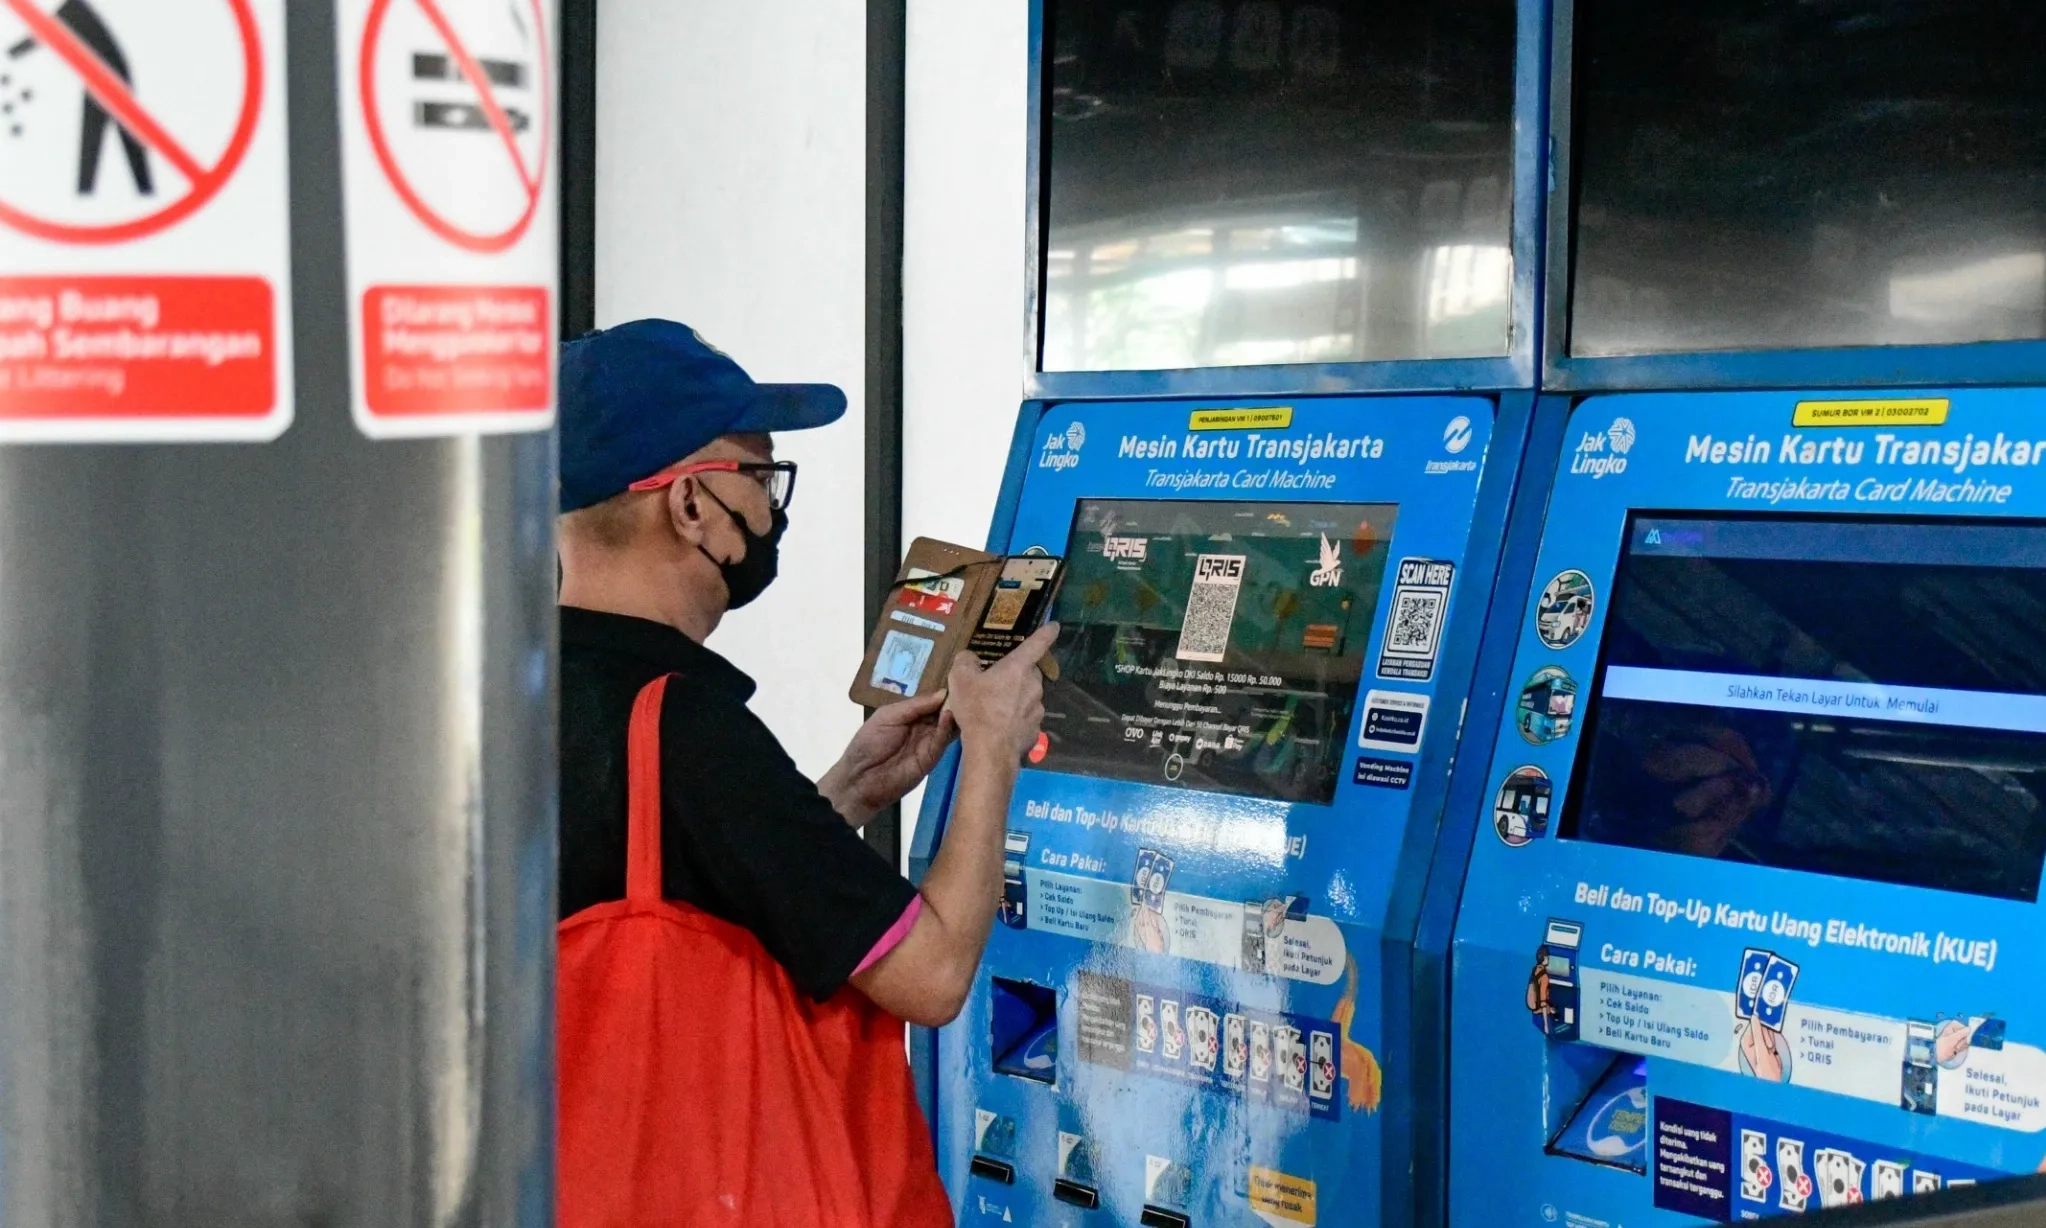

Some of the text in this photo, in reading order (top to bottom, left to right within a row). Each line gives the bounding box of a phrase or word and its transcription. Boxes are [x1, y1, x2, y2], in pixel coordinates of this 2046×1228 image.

[58, 288, 159, 329] Buang
[53, 328, 262, 367] Sembarangan
[1811, 409, 1841, 418] SUMUR
[1841, 408, 1859, 417] BOR
[1860, 408, 1874, 417] VM
[1886, 407, 1930, 417] 03002702
[1042, 432, 1066, 450] Jak
[1118, 432, 1384, 466] Mesin Kartu Transjakarta
[1575, 431, 1607, 452] Jak
[1038, 450, 1080, 472] Lingko
[1685, 432, 2046, 474] Mesin Kartu Transjakar
[1570, 453, 1628, 479] Lingko
[1145, 468, 1336, 492] Transjakarta Card Machine
[1726, 476, 2013, 505] Transjakarta Card Machine
[1103, 536, 1148, 562] QRIS
[1198, 558, 1242, 581] QRIS
[1309, 569, 1342, 587] GPN
[1400, 563, 1452, 586] SCAN HERE
[1135, 665, 1153, 676] Kartu
[1196, 670, 1214, 680] Saldo
[1158, 680, 1176, 692] Biaya
[1176, 681, 1202, 692] Layanan
[1727, 685, 1939, 714] Silahkan Tekan Layar Untuk Memulai
[1125, 727, 1144, 739] OVO
[1359, 762, 1410, 774] Vending Machine
[1366, 773, 1390, 783] diawasi
[1390, 776, 1408, 785] CCTV
[1025, 799, 1118, 834] Beli dan Top-Up
[1041, 847, 1107, 873] Cara Pakai:
[1040, 879, 1054, 890] Pilih
[1044, 892, 1074, 905] Cek Saldo
[1044, 903, 1055, 915] Top
[1079, 910, 1097, 923] Ulang
[1097, 911, 1115, 924] Saldo
[1044, 915, 1089, 932] Beli Kartu Baru
[1574, 882, 1998, 973] Beli dan Top-Up Kartu Uang Elektronik (KUE)
[1301, 951, 1333, 967] Petunjuk
[1600, 943, 1698, 977] Cara Pakai:
[1301, 964, 1321, 978] Layar
[1600, 981, 1620, 994] Pilih
[1606, 998, 1650, 1015] Cek Saldo
[1606, 1011, 1621, 1025] Top
[1623, 1016, 1635, 1028] Up
[1643, 1020, 1654, 1030] Isi
[1656, 1022, 1682, 1039] Ulang
[1684, 1026, 1710, 1042] Saldo
[1800, 1018, 1824, 1033] Pilih
[1605, 1026, 1671, 1049] Beli Kartu Baru
[1807, 1035, 1835, 1050] Tunai
[1807, 1050, 1833, 1066] QRIS
[1965, 1083, 2041, 1109] Ikuti Petunjuk
[1964, 1102, 2022, 1122] pada Layar
[1660, 1120, 1684, 1136] Kondisi
[1684, 1128, 1700, 1142] uang
[1700, 1129, 1717, 1143] tidak
[1660, 1147, 1725, 1174] Mengakibatkan uang
[1660, 1162, 1708, 1182] tersangkut dan
[1660, 1176, 1690, 1191] transaksi
